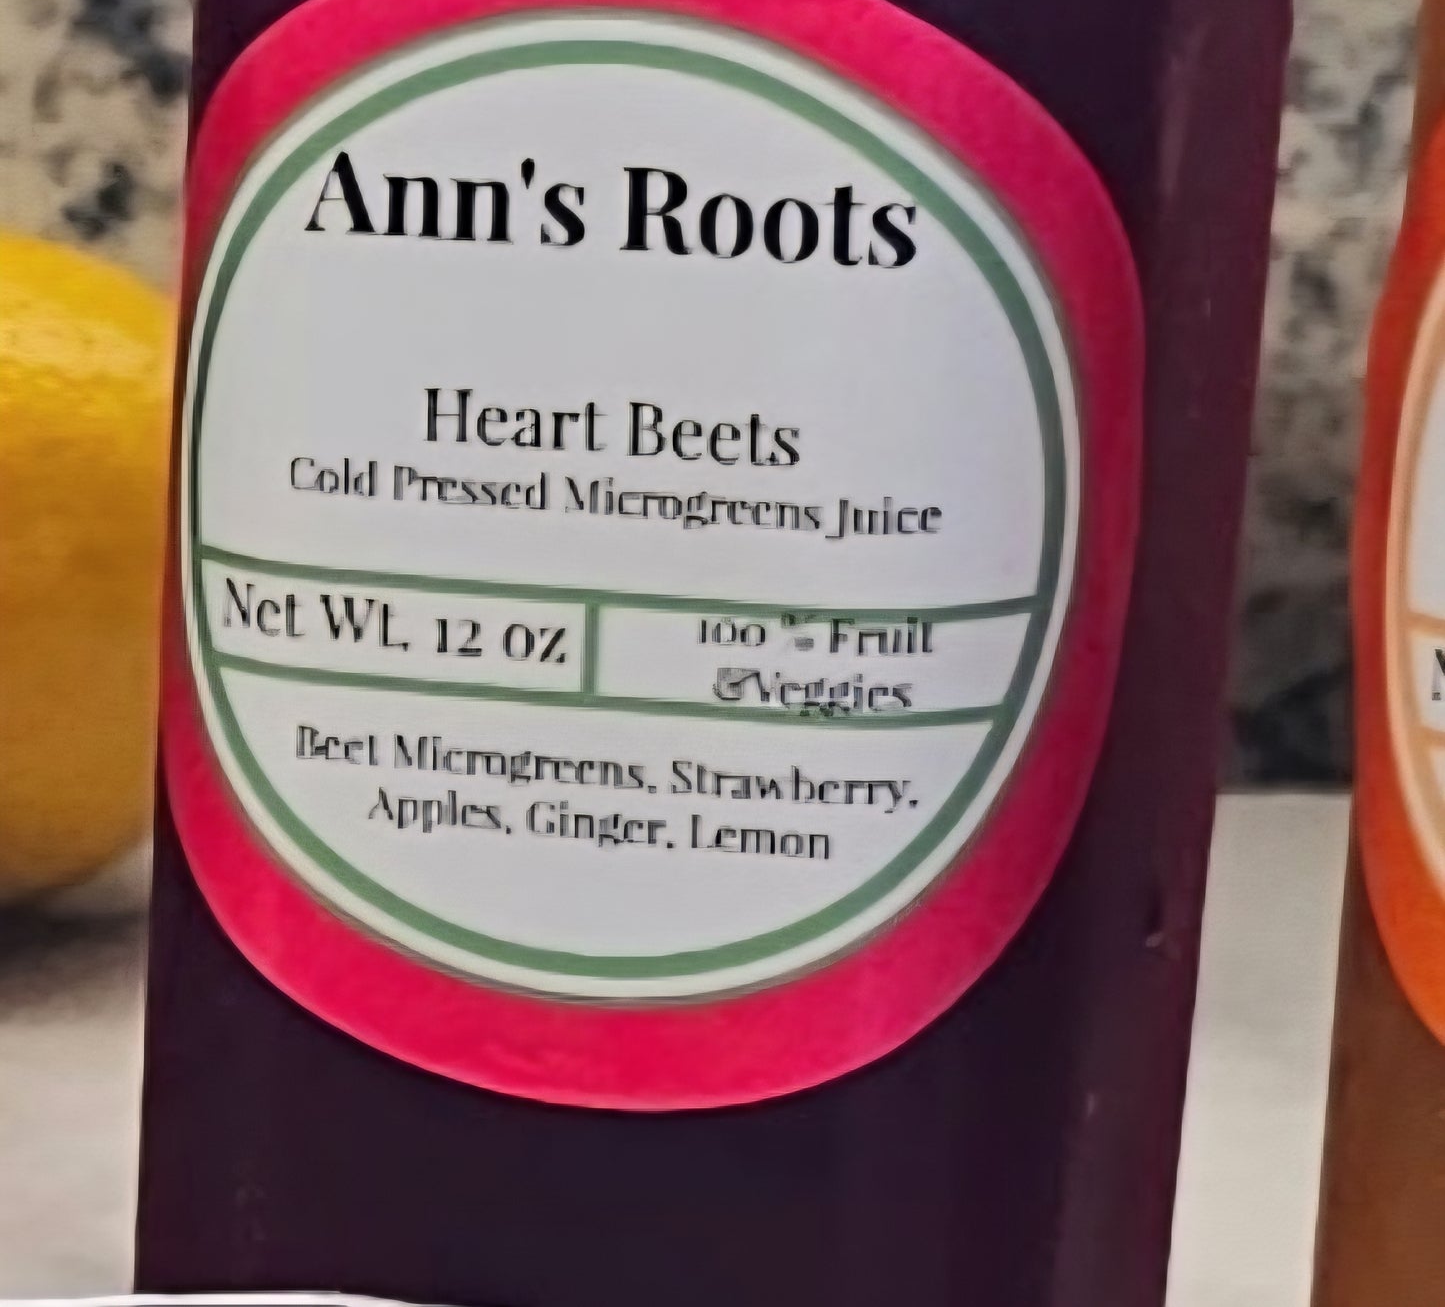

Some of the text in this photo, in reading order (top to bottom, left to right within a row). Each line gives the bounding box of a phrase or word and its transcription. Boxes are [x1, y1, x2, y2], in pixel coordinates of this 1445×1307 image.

[304, 151, 918, 268] Ann's Roots
[424, 388, 800, 466] Heart Beets
[290, 457, 942, 539] Cold Pressed Microgreens Juice
[223, 577, 304, 637] Net
[435, 618, 482, 656] 12
[698, 617, 766, 646] 100
[830, 615, 934, 655] Fruit
[296, 724, 378, 766] Beet
[691, 814, 832, 860] Lemon
